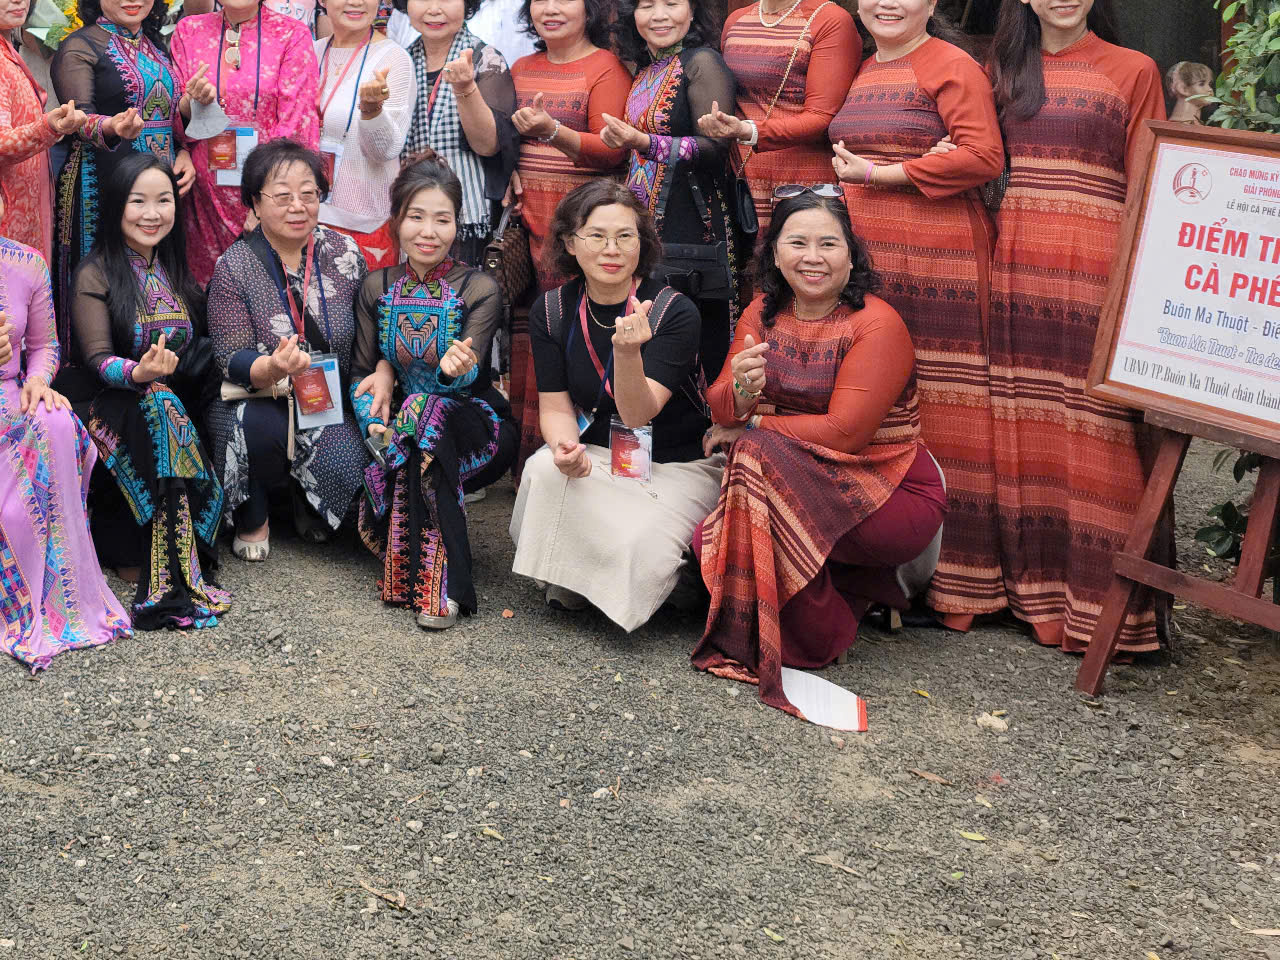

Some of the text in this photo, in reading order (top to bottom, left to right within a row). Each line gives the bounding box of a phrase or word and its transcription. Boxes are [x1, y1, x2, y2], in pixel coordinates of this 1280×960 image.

[1177, 217, 1250, 259] ĐIỂM
[1184, 262, 1220, 295] CÀ
[1163, 299, 1192, 320] Buôn
[1194, 306, 1212, 324] Ma
[1216, 310, 1249, 336] Thuột
[1187, 334, 1206, 353] Ma
[1207, 338, 1237, 359] Thuot
[1245, 347, 1263, 366] The
[1123, 357, 1149, 376] UBND
[1188, 371, 1202, 390] Ma
[1204, 375, 1230, 400] Thuột
[1231, 384, 1254, 404] chân
